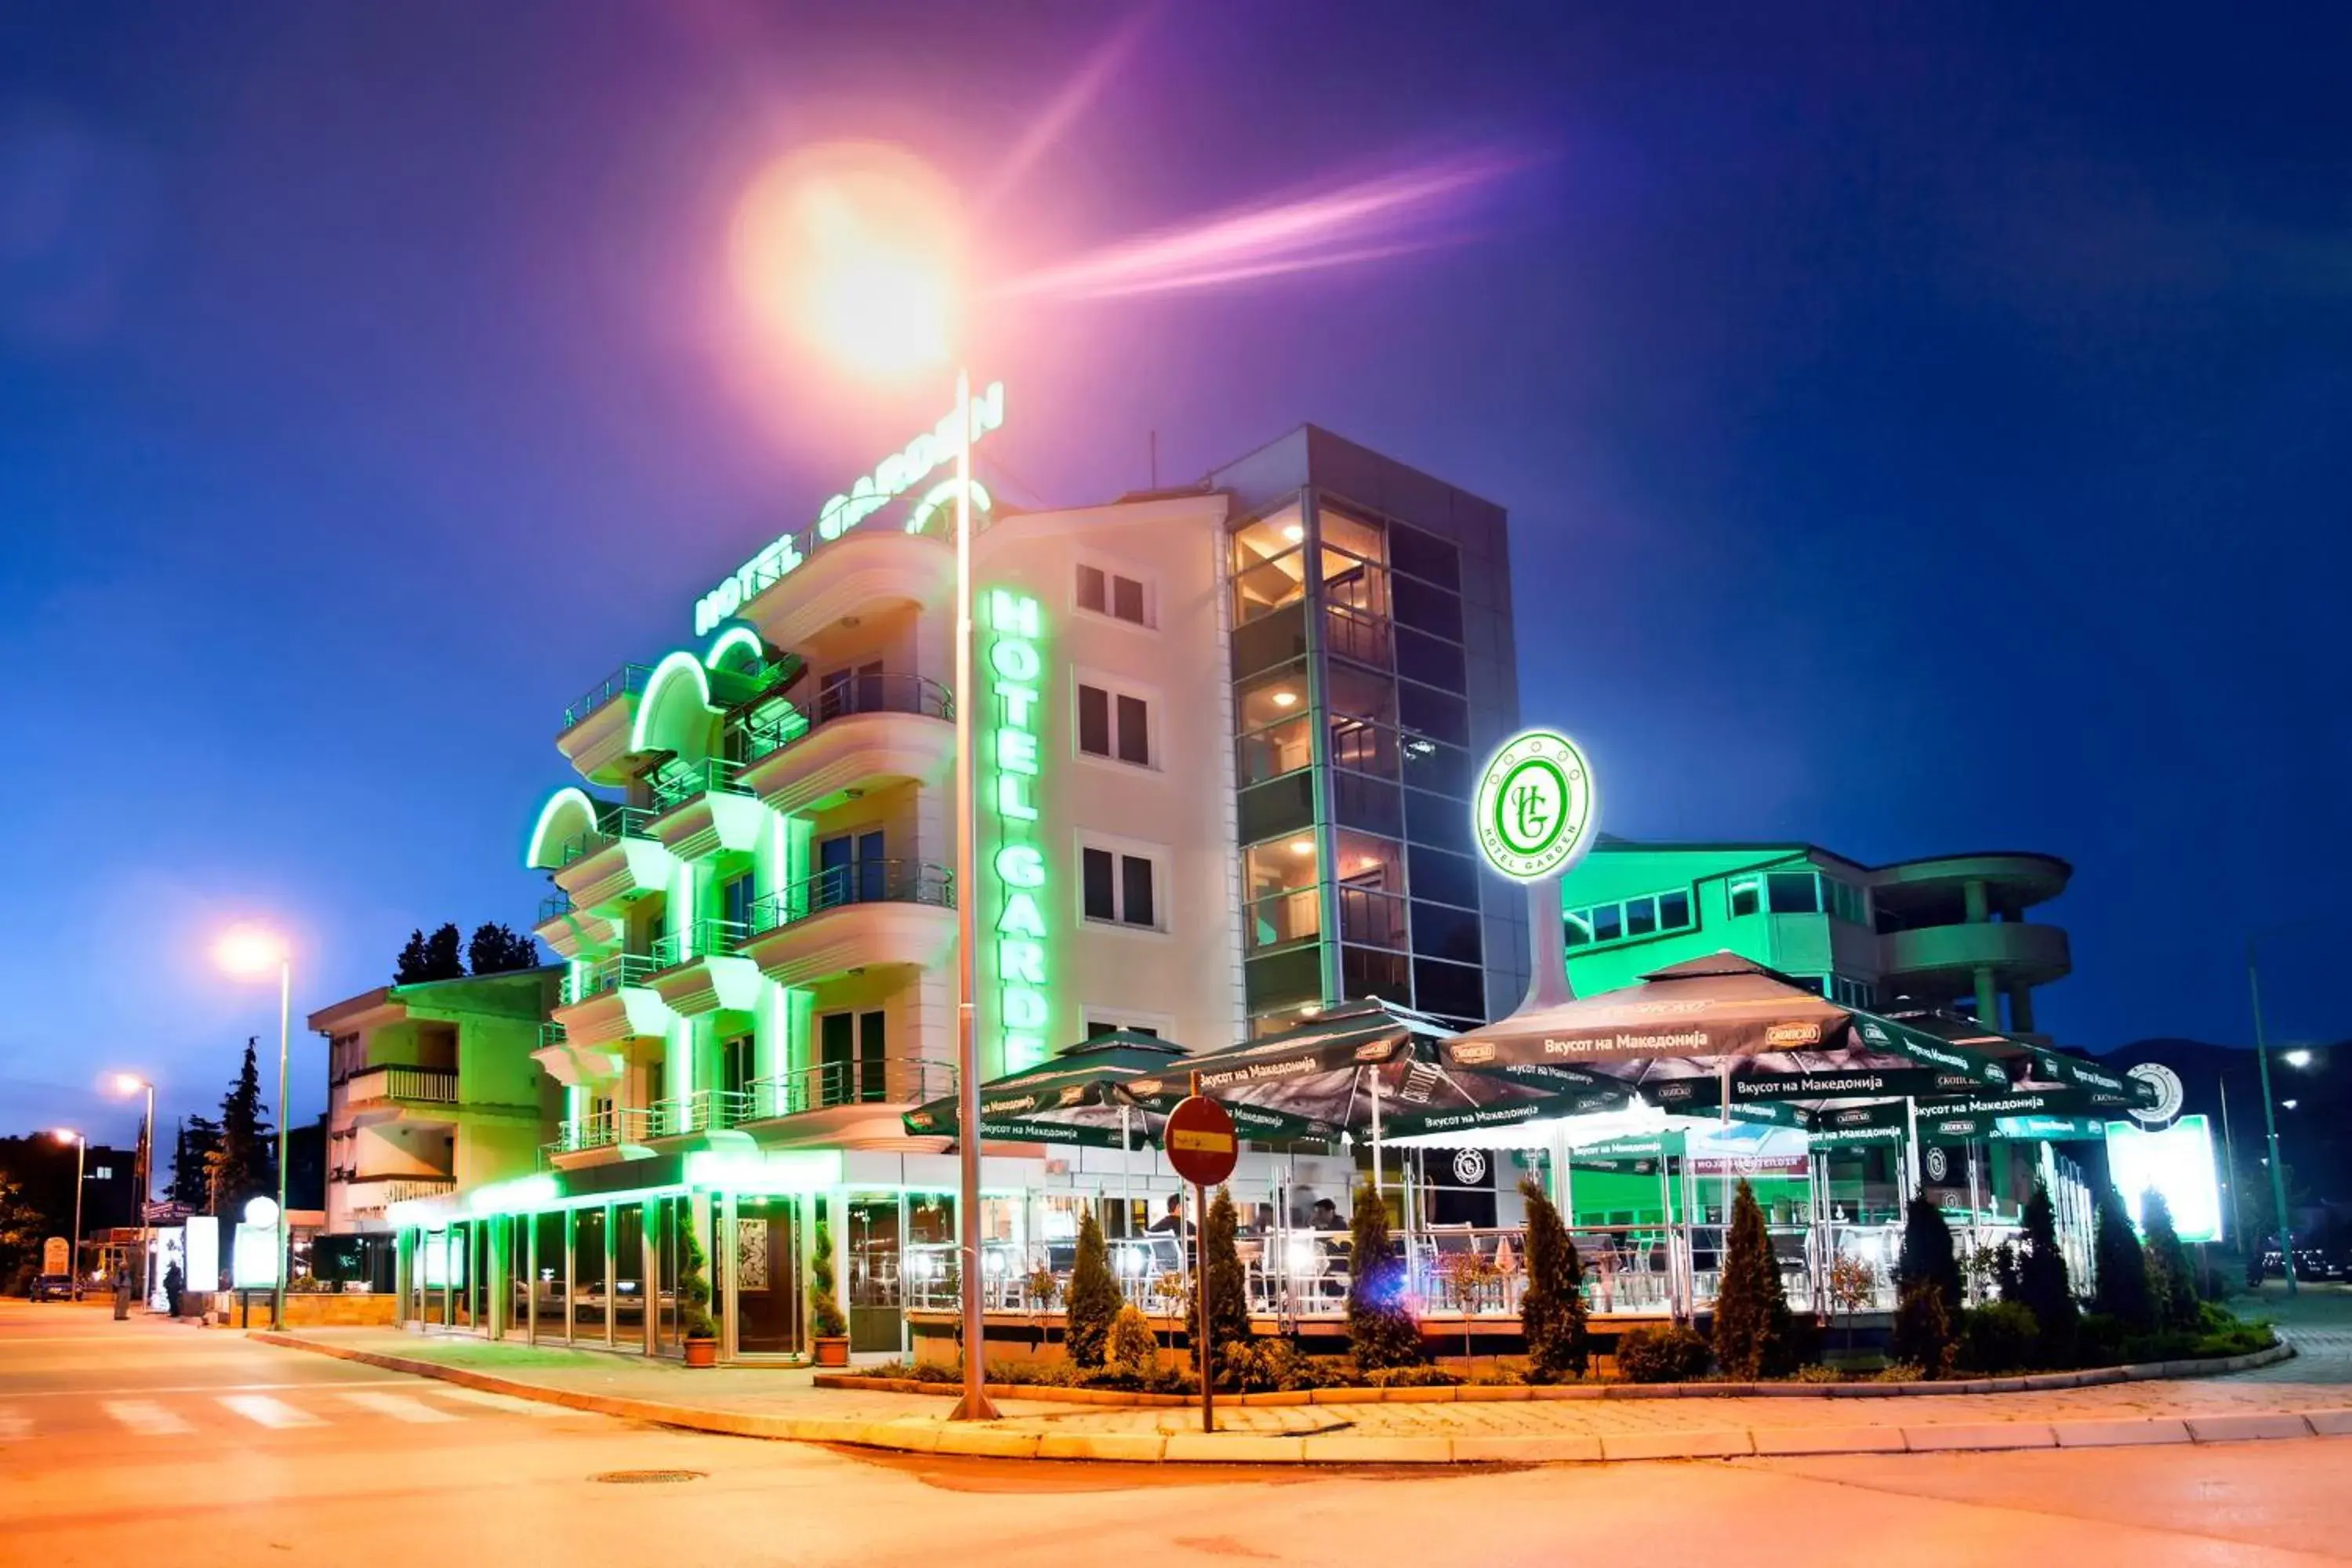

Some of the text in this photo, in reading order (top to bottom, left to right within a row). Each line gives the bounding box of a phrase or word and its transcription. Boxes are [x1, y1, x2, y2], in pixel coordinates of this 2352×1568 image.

[695, 534, 803, 637] HOTEL
[989, 590, 1042, 821] HOTEL
[1486, 826, 1577, 869] HOTEL GARDEN
[1544, 1030, 1708, 1055] Вкусот на Македонија
[1235, 1069, 1248, 1080] на
[1250, 1056, 1316, 1077] Македонија
[1737, 1075, 1882, 1095] Вкусот на Македонија
[1953, 1104, 1966, 1113] на
[1969, 1096, 2044, 1112] Македонија
[1425, 1106, 1539, 1128] Вкусот на Македонија
[1012, 1124, 1023, 1134] на
[1025, 1124, 1078, 1140] Македонија
[1840, 1126, 1901, 1138] Македонија
